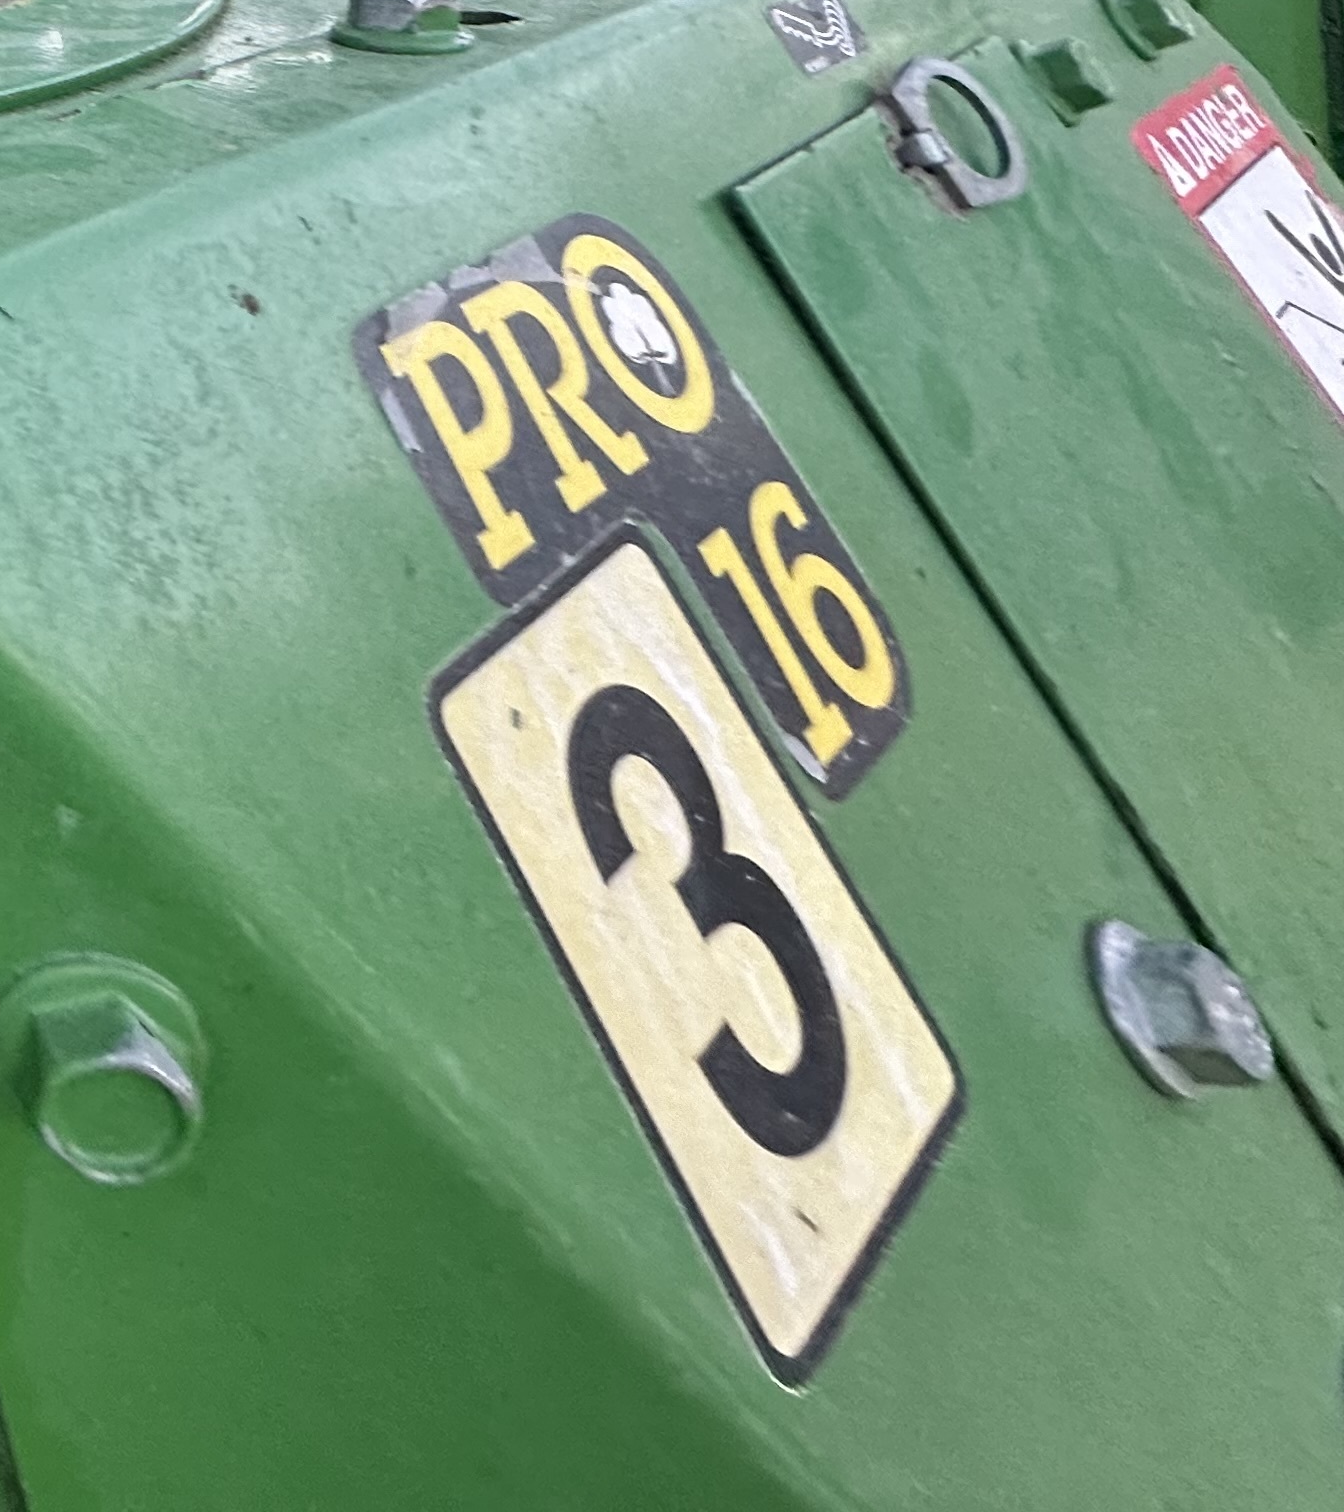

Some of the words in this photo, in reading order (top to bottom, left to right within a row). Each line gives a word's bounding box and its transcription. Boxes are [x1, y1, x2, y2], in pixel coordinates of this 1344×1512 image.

[1165, 84, 1267, 181] DANGER
[379, 234, 716, 571] PRO
[696, 480, 895, 766] 16
[567, 684, 848, 1158] 3
